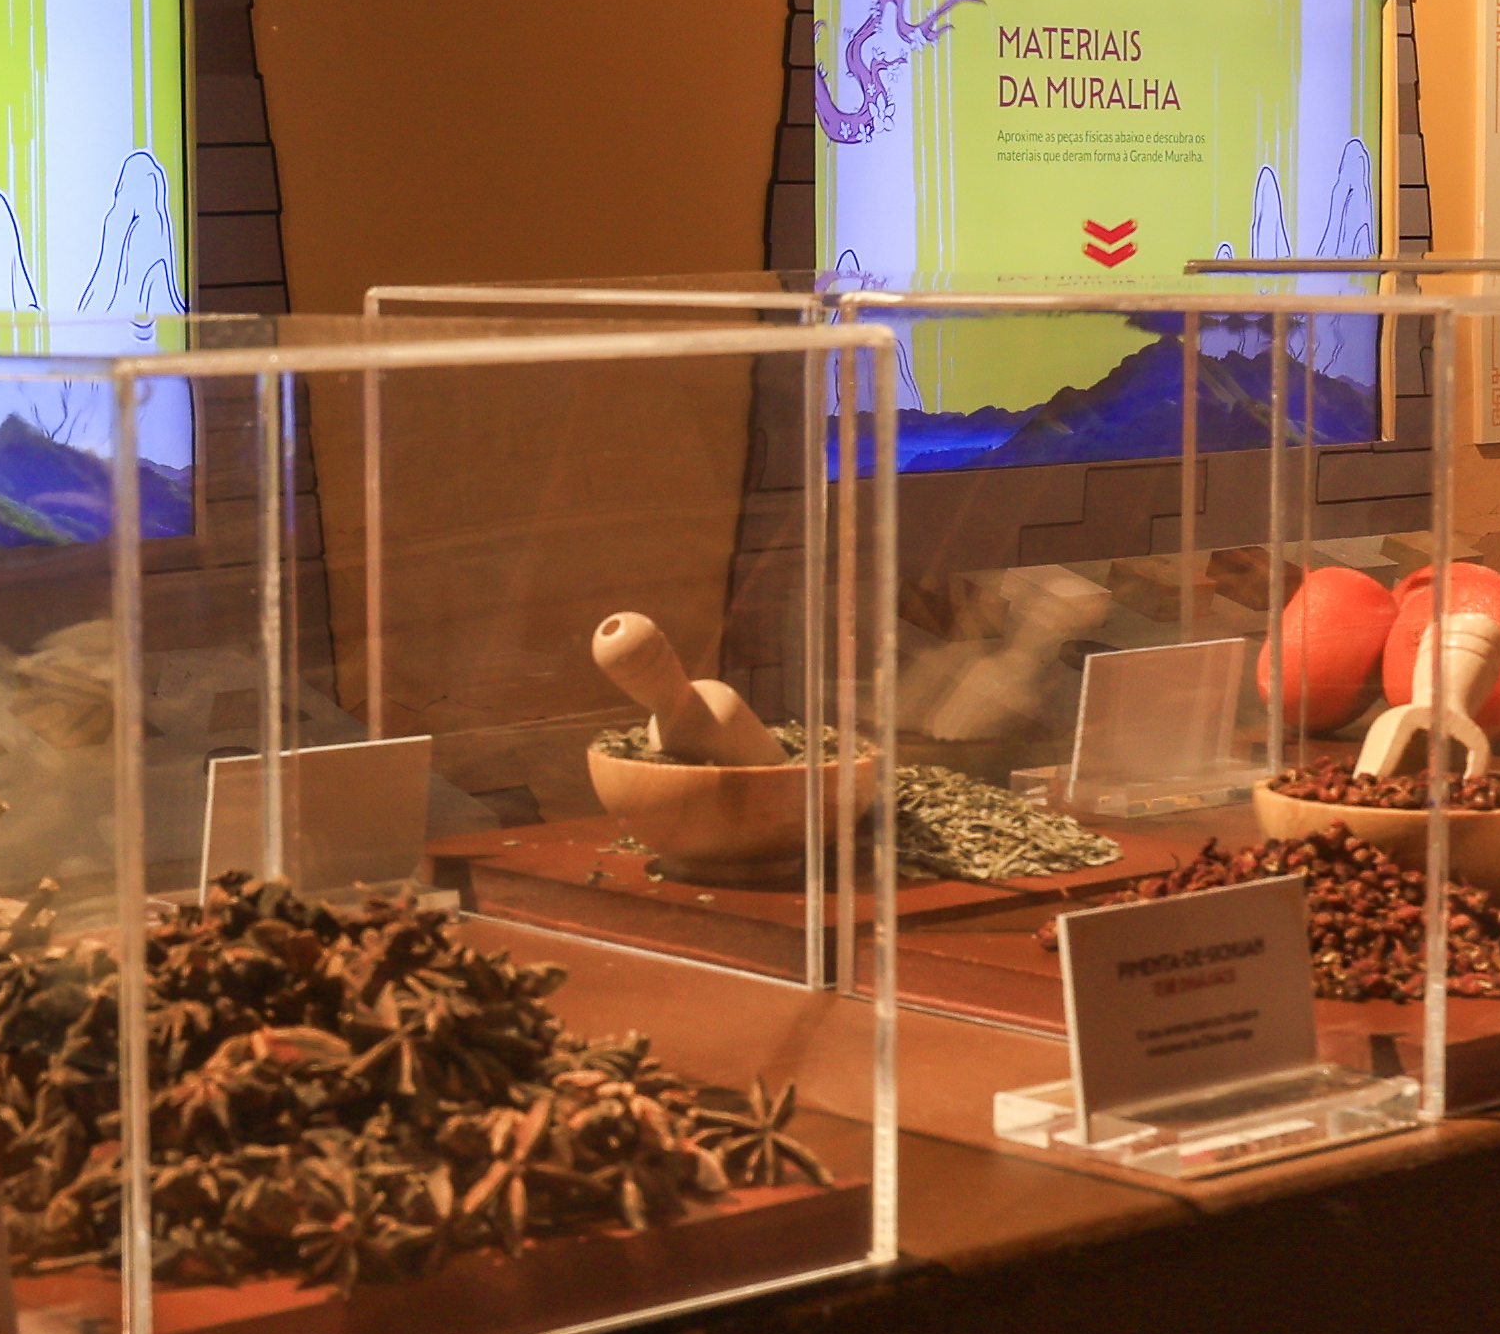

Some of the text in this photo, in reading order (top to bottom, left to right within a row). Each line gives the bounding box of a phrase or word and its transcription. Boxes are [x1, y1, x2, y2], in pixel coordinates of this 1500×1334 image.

[999, 26, 1141, 61] MATERIAIS
[1000, 75, 1180, 110] DA MURALHA
[998, 130, 1205, 145] Aproxime as peças físicas abaixo e descubra os
[998, 149, 1203, 163] materiais que deram forma à Grande Muralha.
